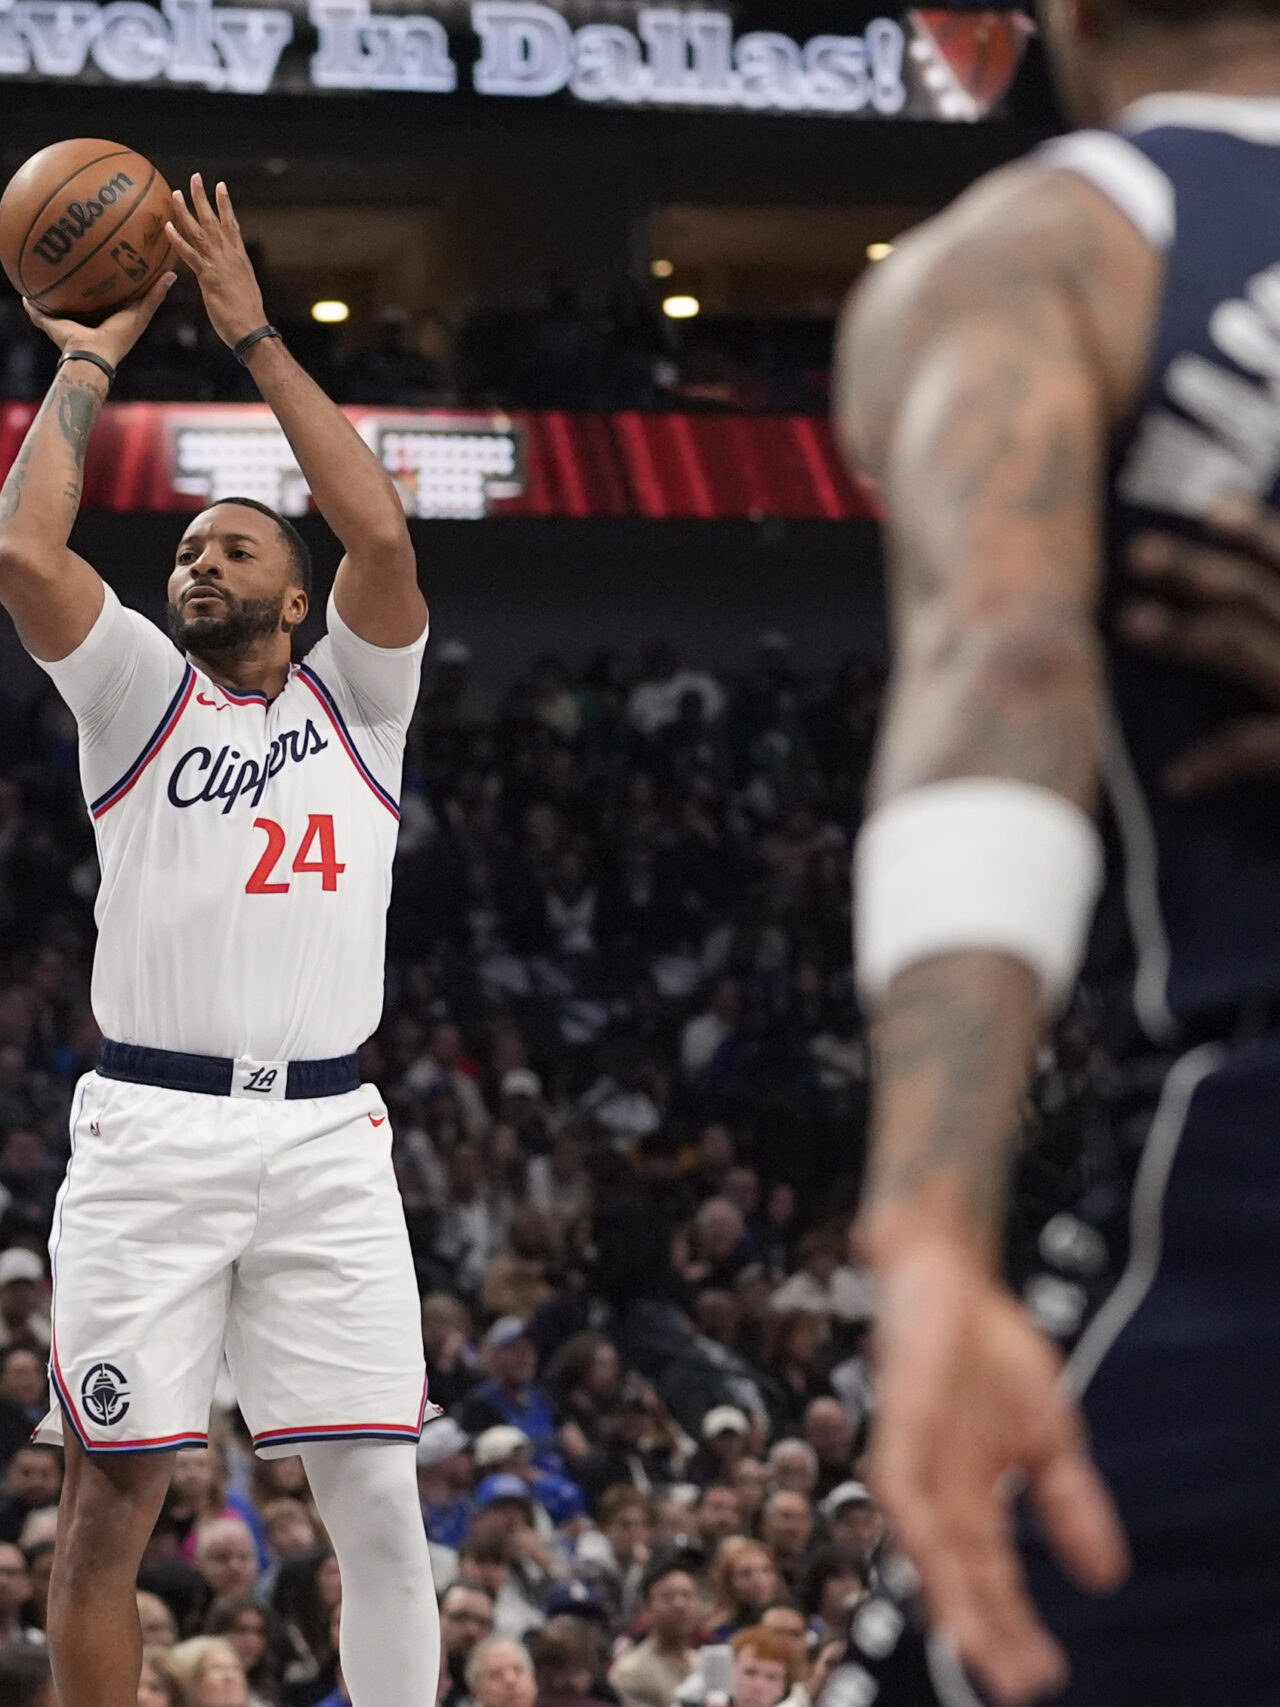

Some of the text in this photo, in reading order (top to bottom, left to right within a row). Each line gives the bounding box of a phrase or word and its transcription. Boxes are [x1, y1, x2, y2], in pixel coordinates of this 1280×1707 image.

[308, 0, 458, 93] In
[472, 3, 906, 115] Dallas!
[32, 171, 135, 265] Wilson
[245, 814, 346, 894] 24
[242, 1066, 278, 1093] LA
